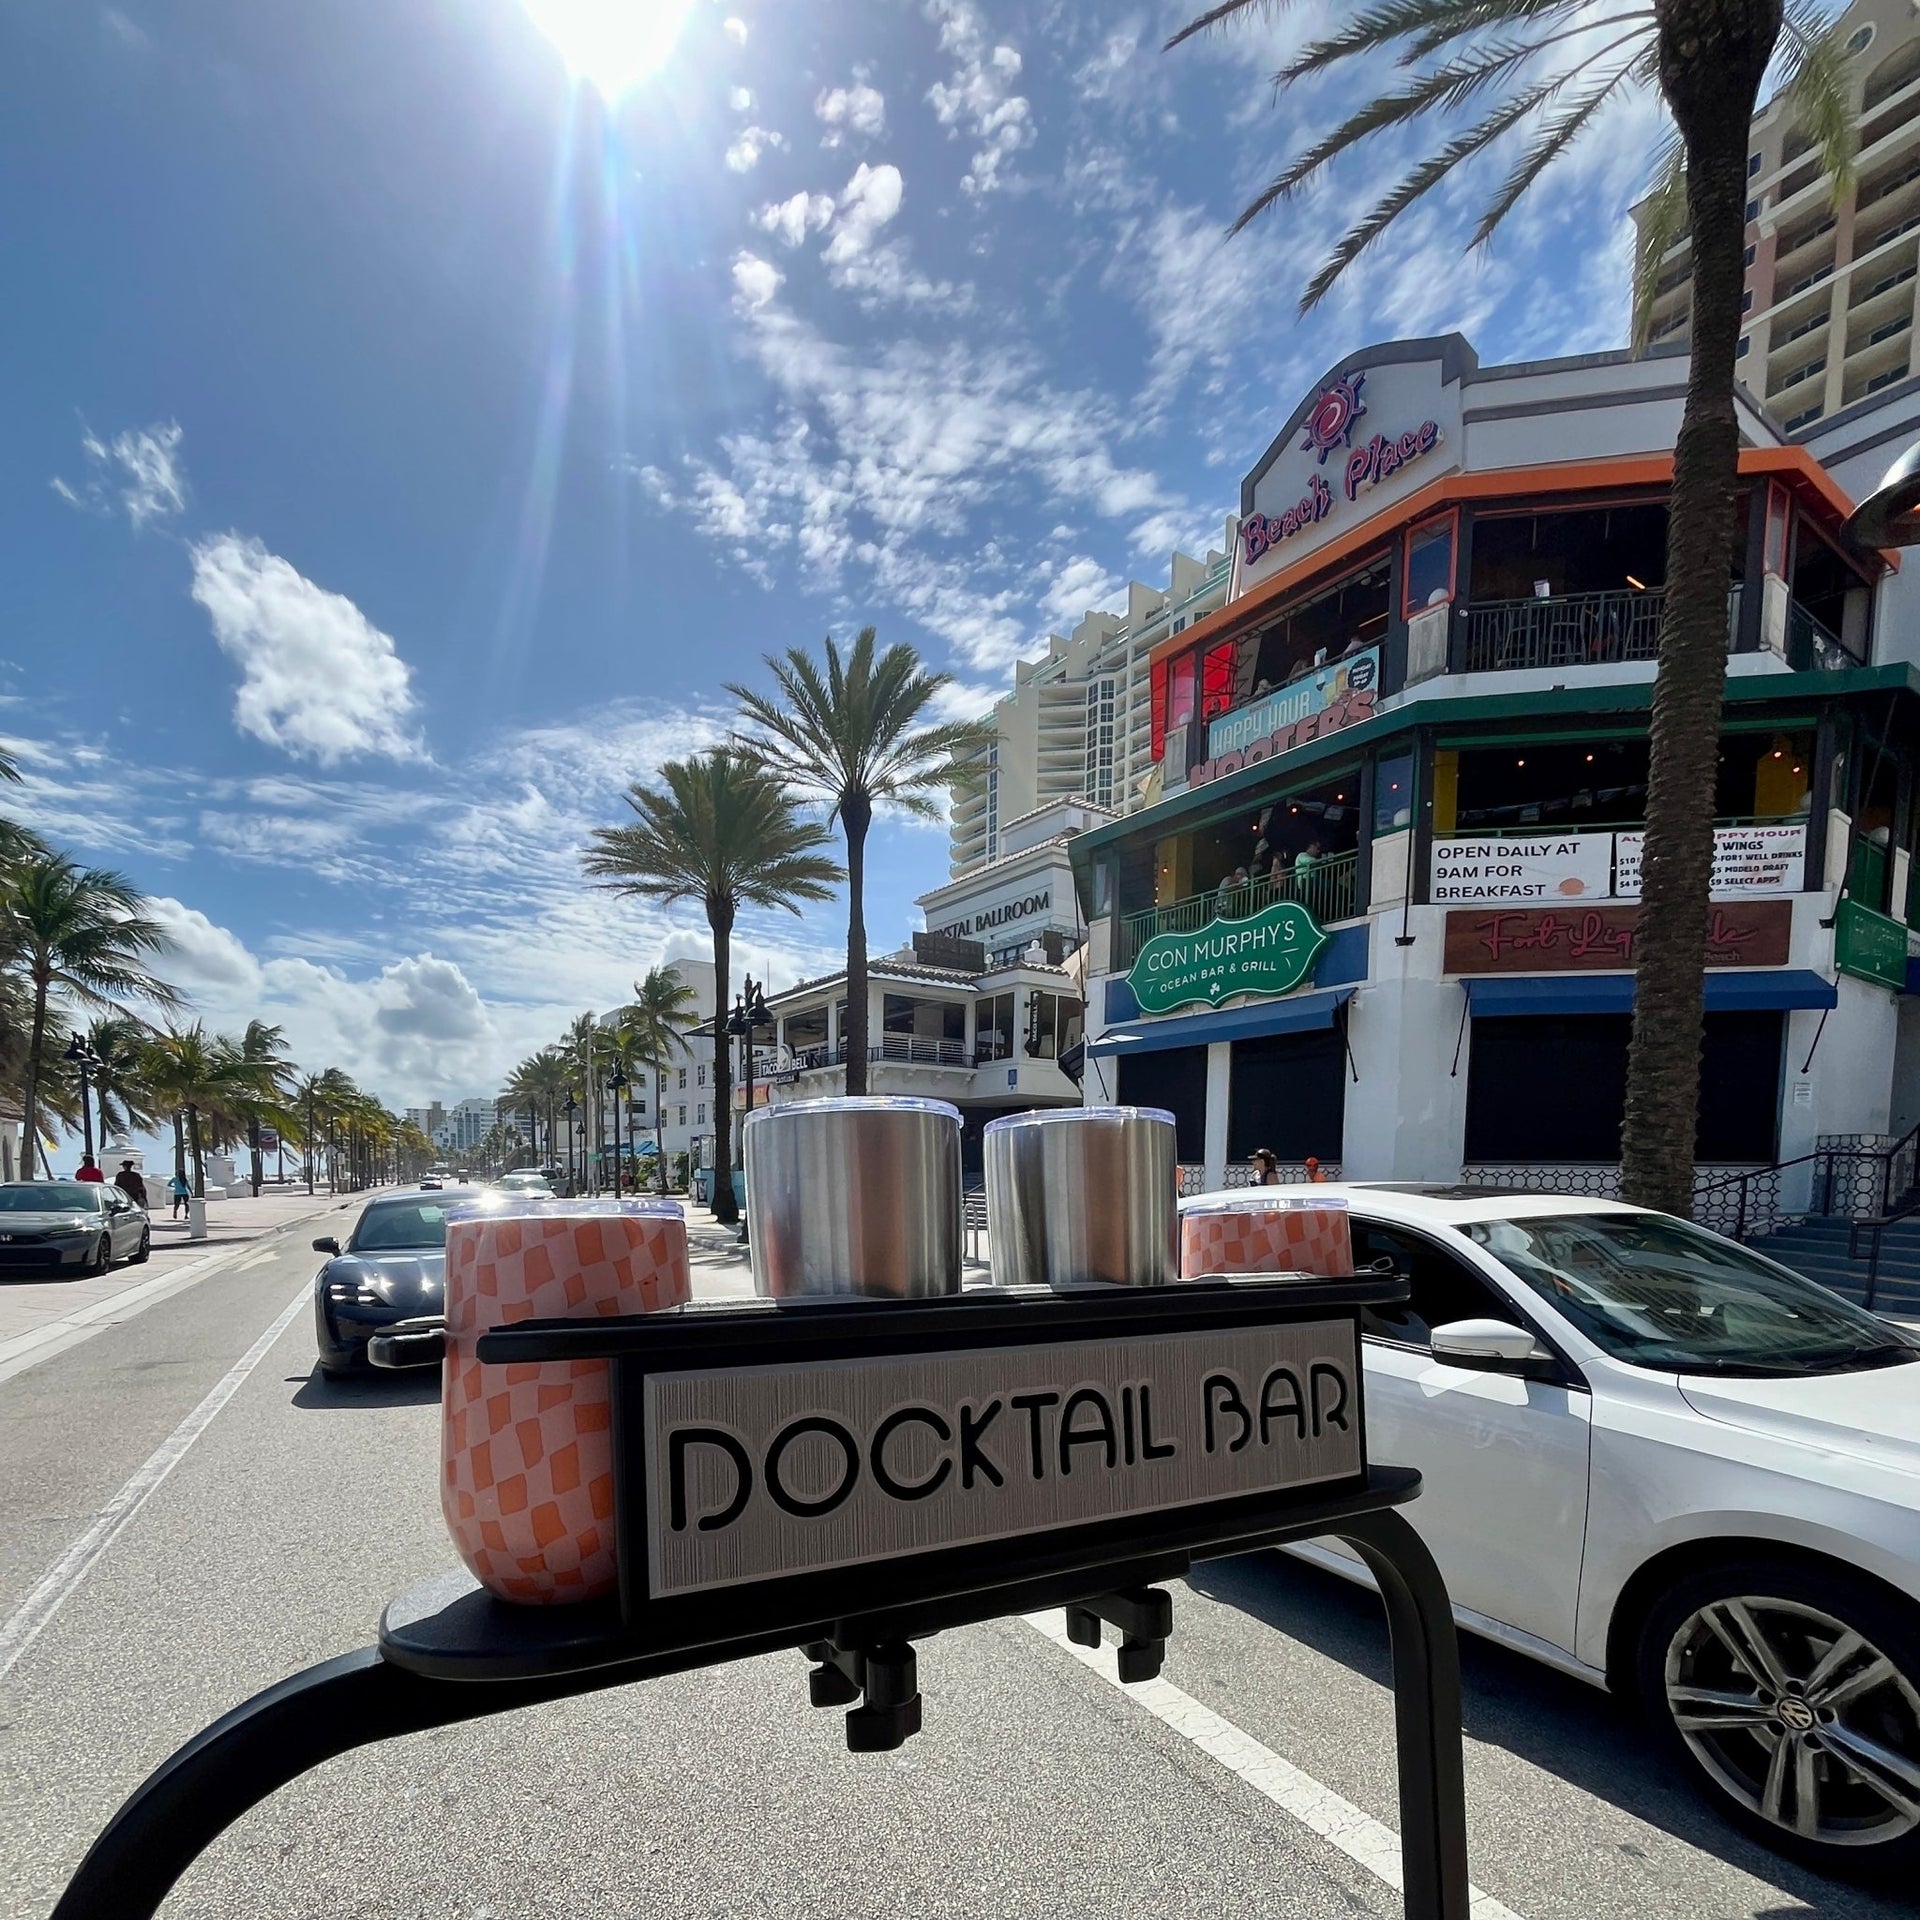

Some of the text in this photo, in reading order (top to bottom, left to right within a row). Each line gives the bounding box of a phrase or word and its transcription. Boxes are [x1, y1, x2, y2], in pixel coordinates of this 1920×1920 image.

[1240, 420, 1440, 565] Beach Place
[1214, 690, 1311, 755] HAPPY HOUR
[1190, 689, 1375, 790] HOOTERS
[1754, 829, 1801, 838] HOUR
[1437, 842, 1581, 859] OPEN DAILY AT
[1722, 841, 1764, 851] WINGS
[1619, 857, 1636, 865] $10
[1745, 853, 1769, 861] WELL
[1771, 851, 1803, 859] DRINKS
[1436, 865, 1523, 879] 9AM FOR
[1762, 863, 1789, 871] DRAFT
[1619, 880, 1630, 888] $4
[1724, 877, 1755, 885] SELECT
[1756, 876, 1780, 884] APPS
[1436, 884, 1546, 898] BREAKFAST
[975, 891, 1050, 932] BALLROOM
[1475, 912, 1570, 960] Fort
[1147, 920, 1296, 972] CON MURPHY'S
[1160, 961, 1277, 993] OCEAN BAR & GRILL
[762, 1056, 808, 1075] TACO BELL
[669, 1363, 1348, 1531] DOCKTAIL BAR
